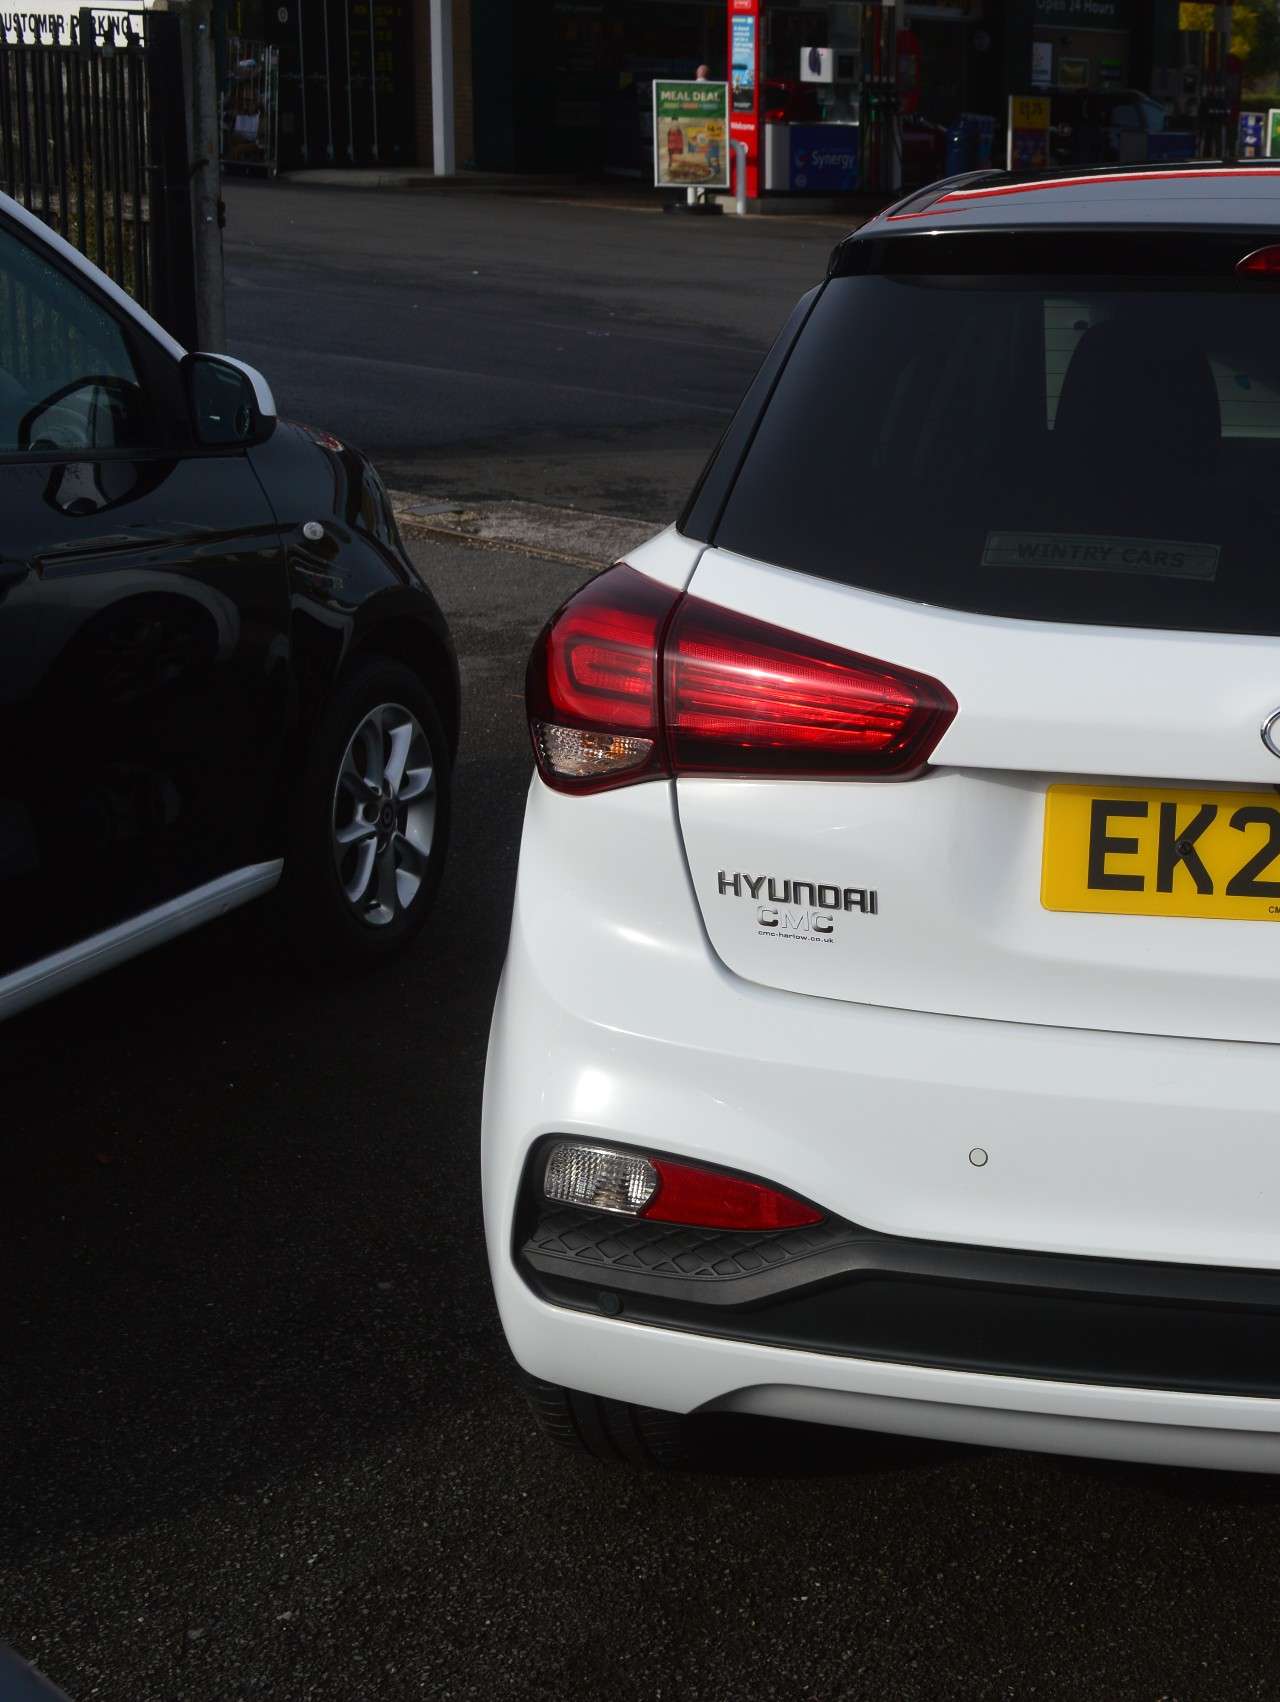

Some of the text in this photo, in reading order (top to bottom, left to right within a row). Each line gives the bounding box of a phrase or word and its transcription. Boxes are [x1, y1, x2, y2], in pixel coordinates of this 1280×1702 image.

[0, 12, 66, 33] USTOMER
[661, 91, 721, 102] MEAL DEAL
[811, 149, 856, 169] Synergy
[1016, 542, 1185, 569] WINTRY CARS
[717, 869, 879, 915] HYUNDAI
[756, 904, 834, 933] CMC
